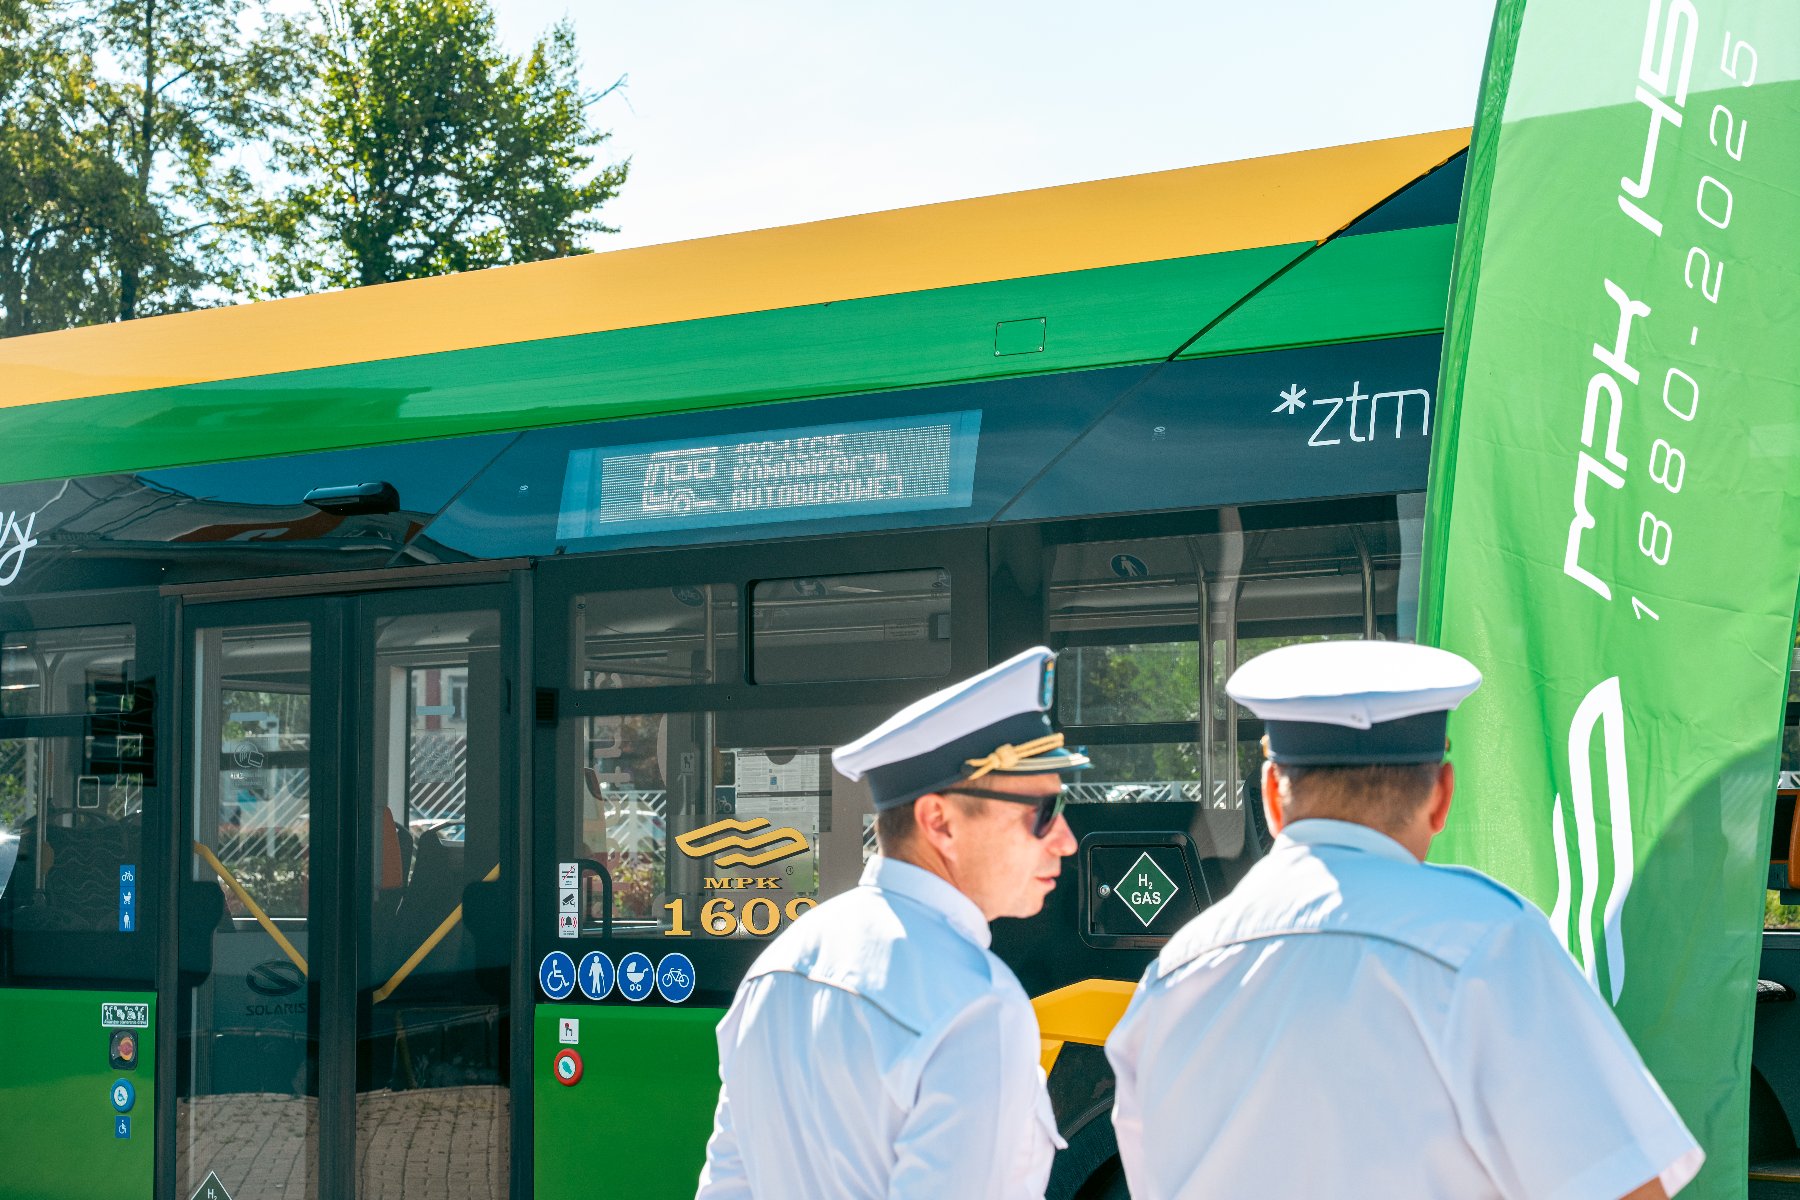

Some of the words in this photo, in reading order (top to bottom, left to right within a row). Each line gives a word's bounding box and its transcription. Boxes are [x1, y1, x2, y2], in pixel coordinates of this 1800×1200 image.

[1631, 31, 1758, 621] 1880-2025
[1564, 278, 1651, 600] MPK
[703, 877, 783, 890] MPK
[1131, 891, 1162, 905] GAS
[245, 1002, 307, 1017] SOLARIS
